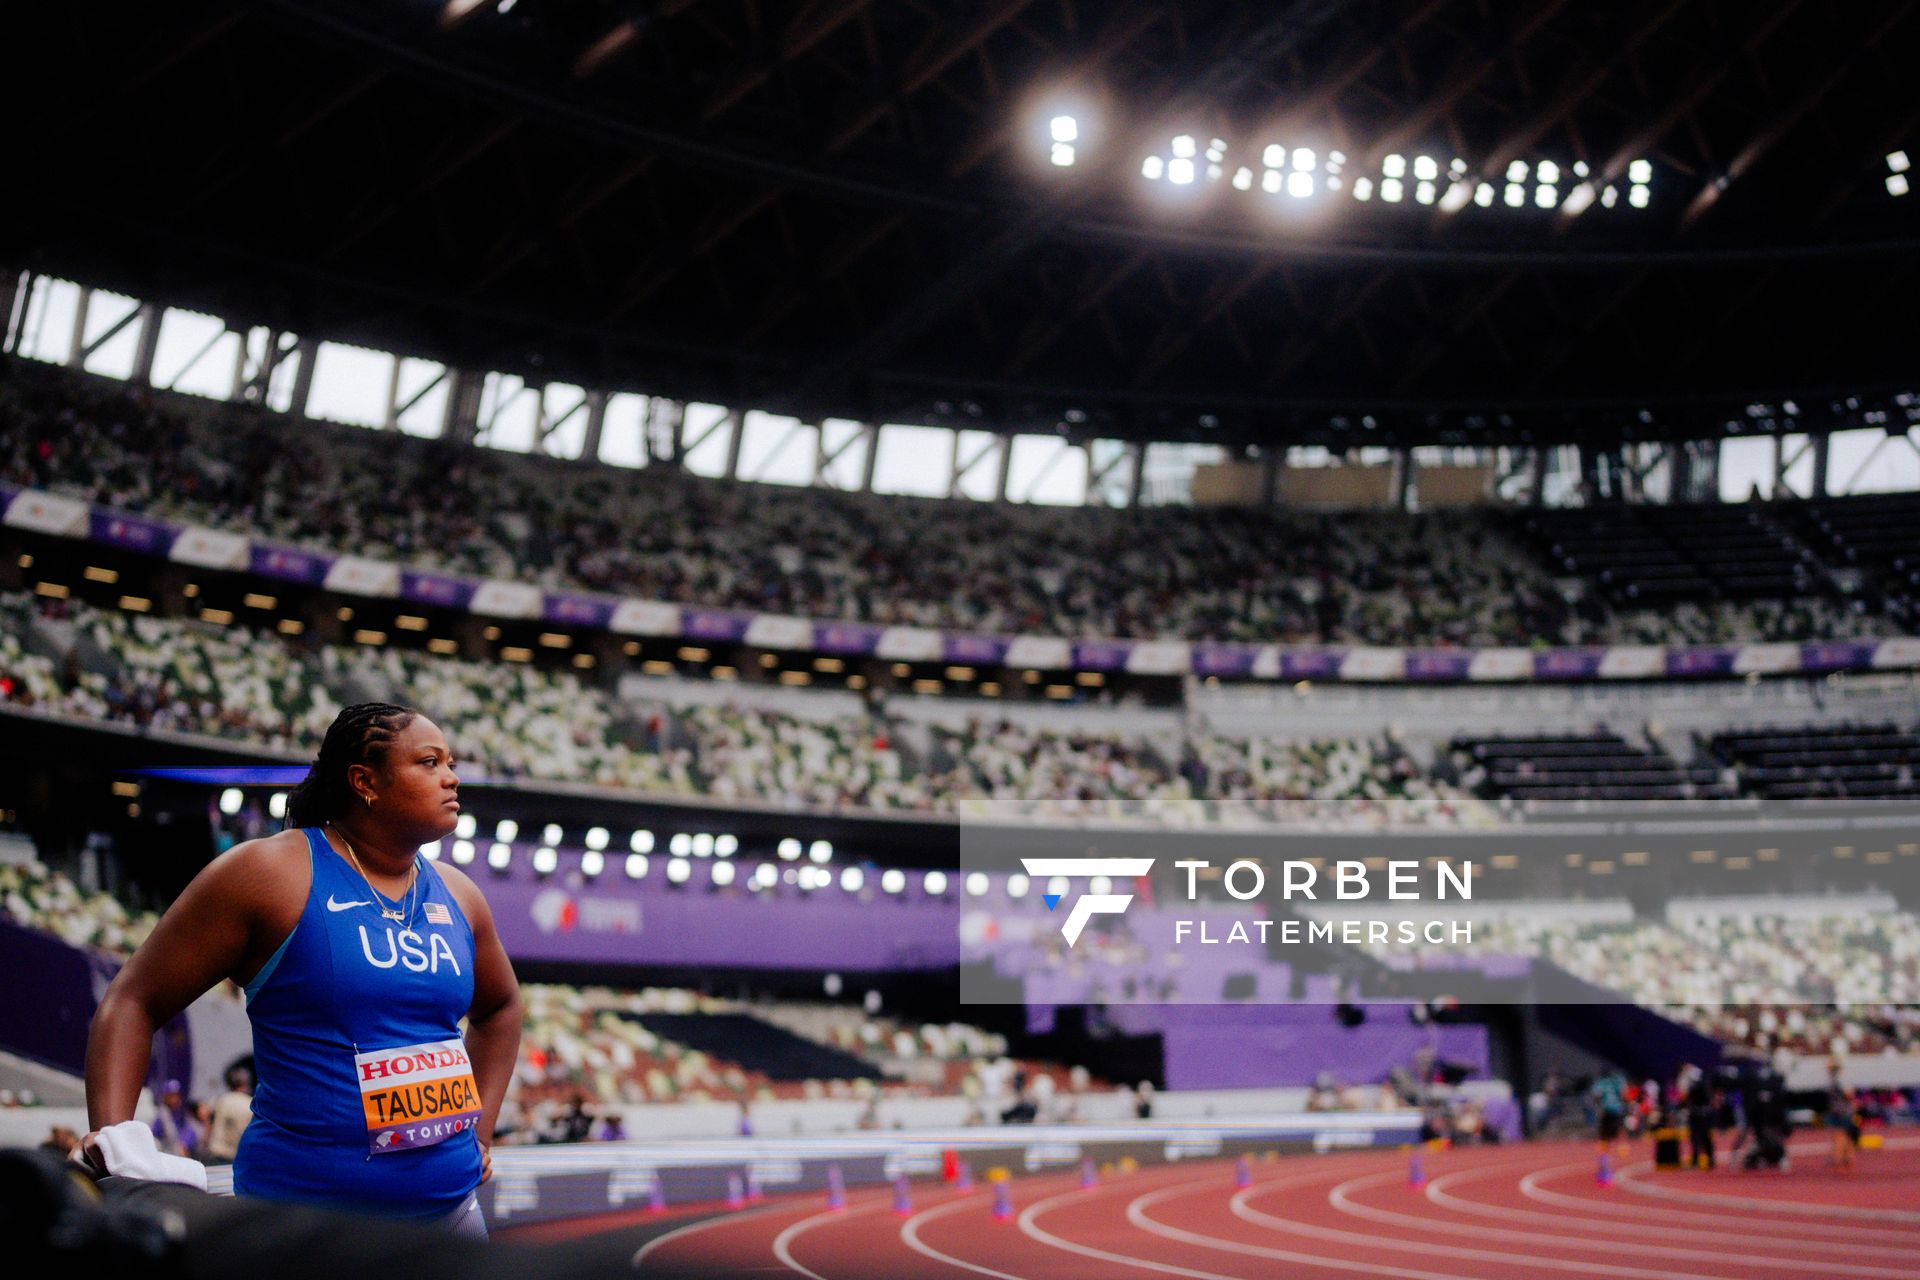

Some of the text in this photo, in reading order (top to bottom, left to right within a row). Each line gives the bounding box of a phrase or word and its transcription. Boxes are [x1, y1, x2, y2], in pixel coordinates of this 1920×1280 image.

[358, 925, 461, 977] USA
[359, 1049, 468, 1081] HONDA
[369, 1079, 477, 1123] TAUSAGA
